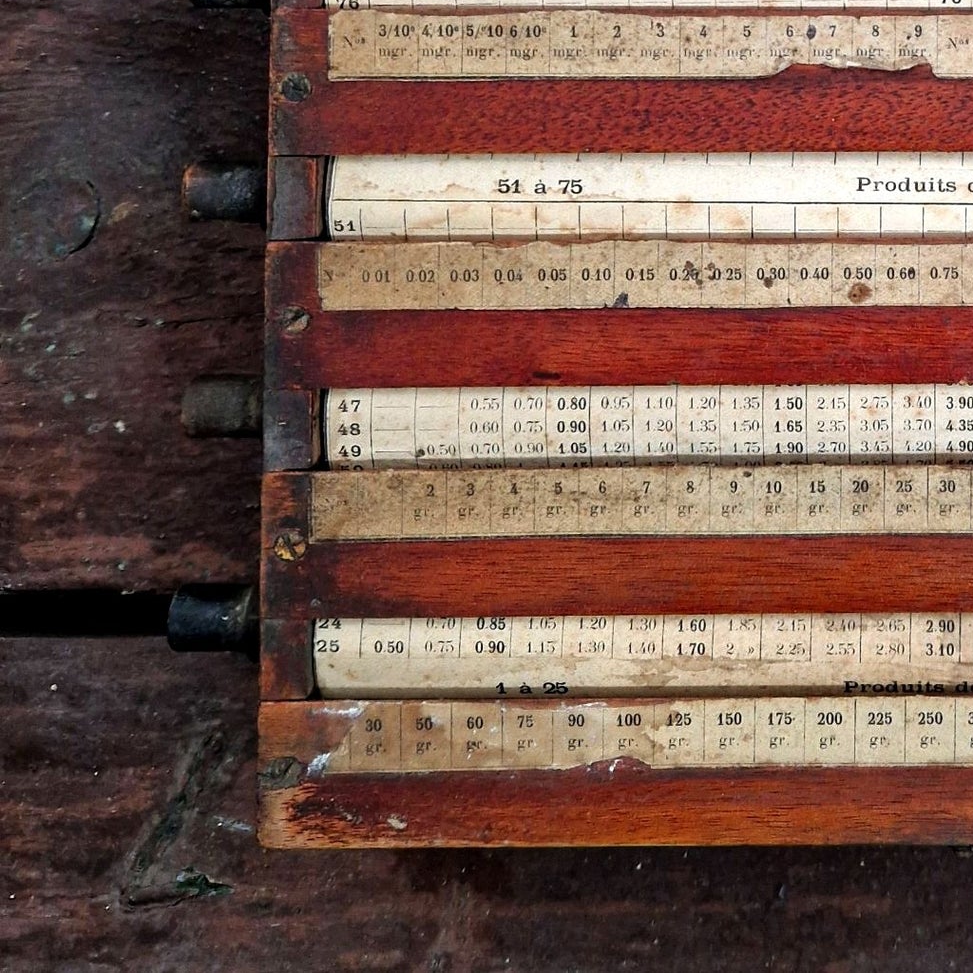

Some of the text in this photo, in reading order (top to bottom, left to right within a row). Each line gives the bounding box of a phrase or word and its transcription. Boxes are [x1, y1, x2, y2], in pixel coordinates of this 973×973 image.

[498, 179, 582, 194] 51 à 75
[856, 178, 957, 193] Produits
[339, 397, 586, 412] 47 0.80
[317, 640, 505, 654] 25 0.50 0.90
[843, 681, 944, 693] Produits
